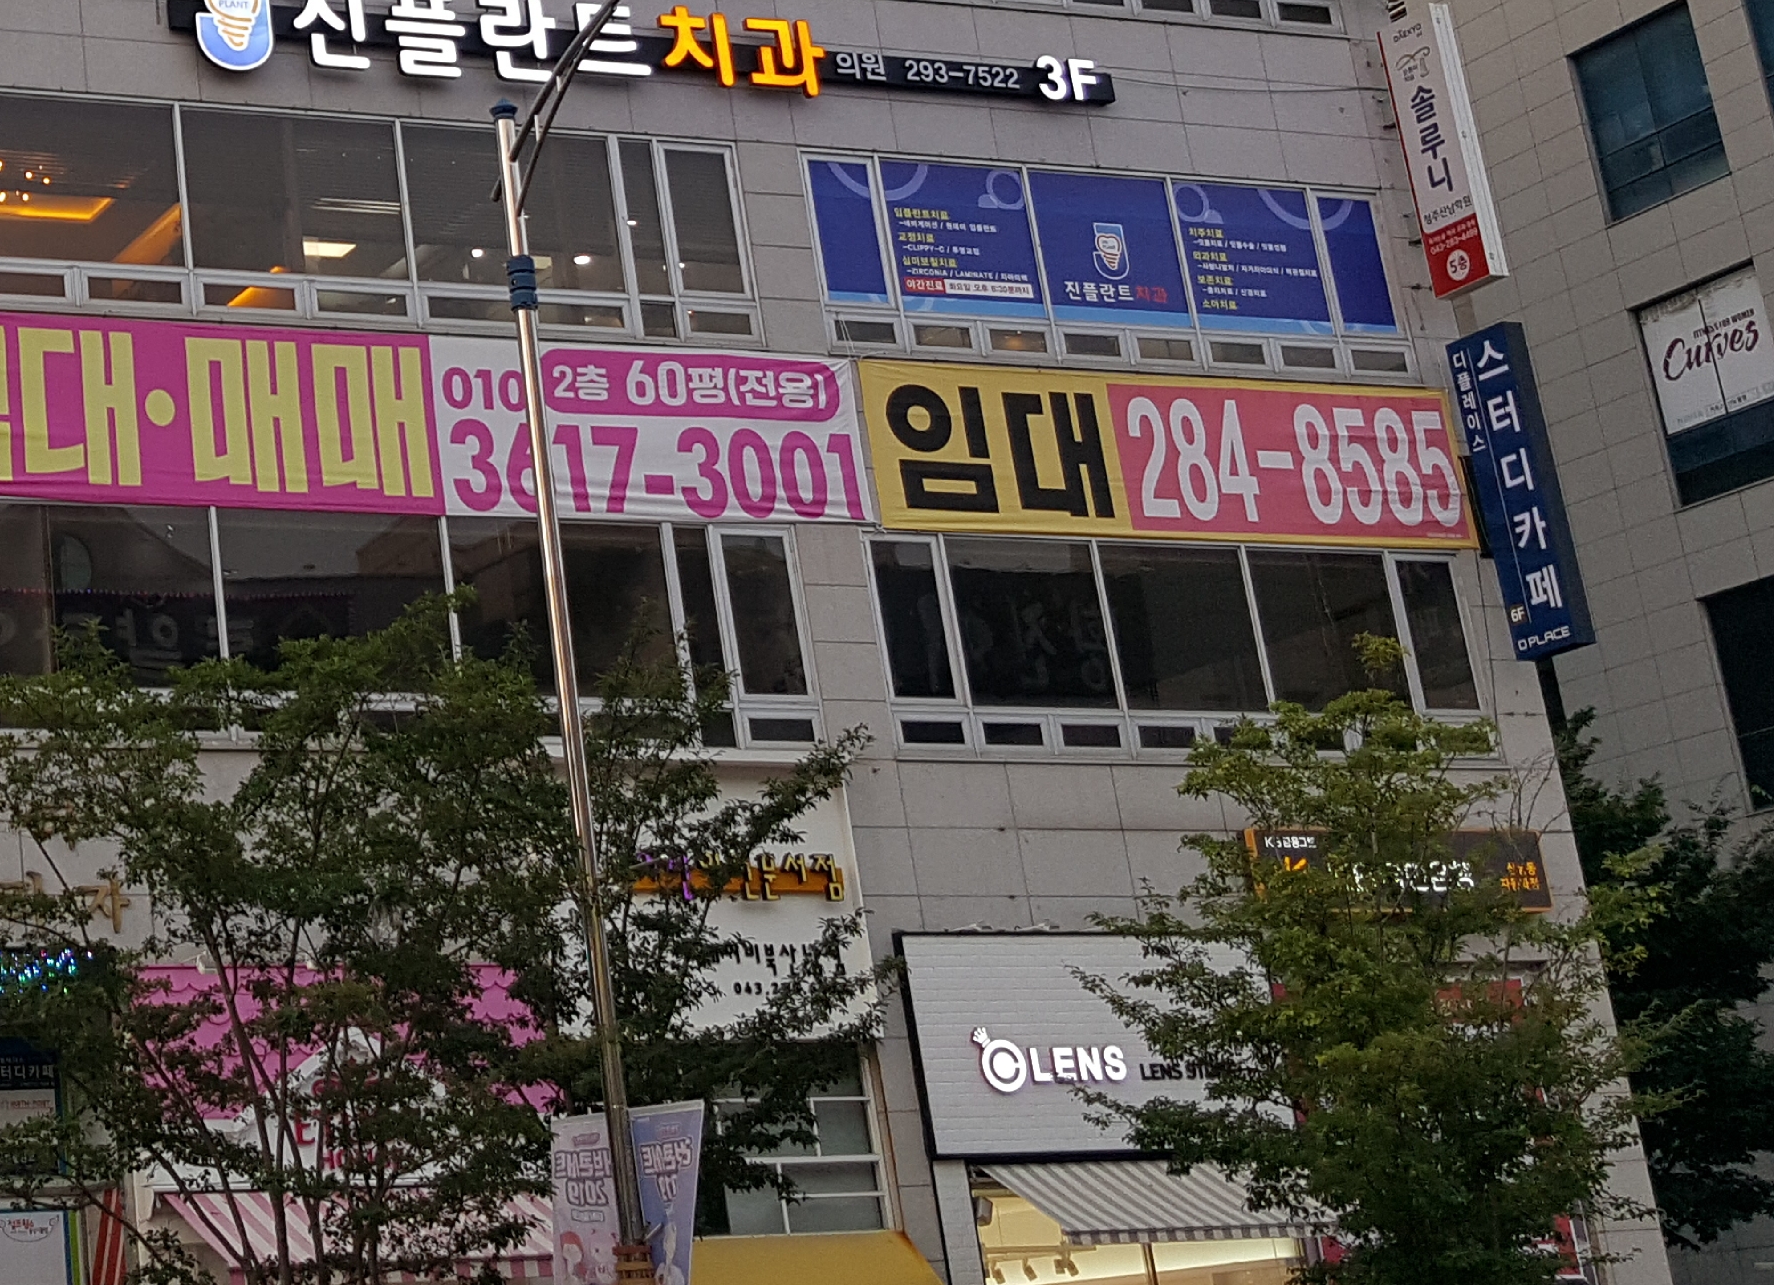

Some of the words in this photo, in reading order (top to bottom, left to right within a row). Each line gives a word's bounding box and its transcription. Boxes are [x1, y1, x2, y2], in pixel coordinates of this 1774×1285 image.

[657, 3, 826, 99] 치과
[835, 50, 887, 84] 의원
[904, 58, 1021, 91] 293-7522
[1036, 56, 1098, 105] 3F
[1409, 84, 1454, 193] 솔루니
[1064, 280, 1135, 303] 진플란트
[441, 366, 527, 413] 010
[552, 364, 610, 401] 2층
[627, 360, 827, 411] 60평(전용)
[1662, 319, 1760, 382] Curves
[1451, 350, 1487, 454] 디플레이스
[448, 417, 866, 521] 3617-3001
[884, 382, 1116, 519] 임대
[1126, 394, 1463, 529] 284-8585
[1476, 338, 1564, 610] 스터디카페
[1510, 604, 1526, 623] 6F
[1138, 1062, 1183, 1081] LENS
